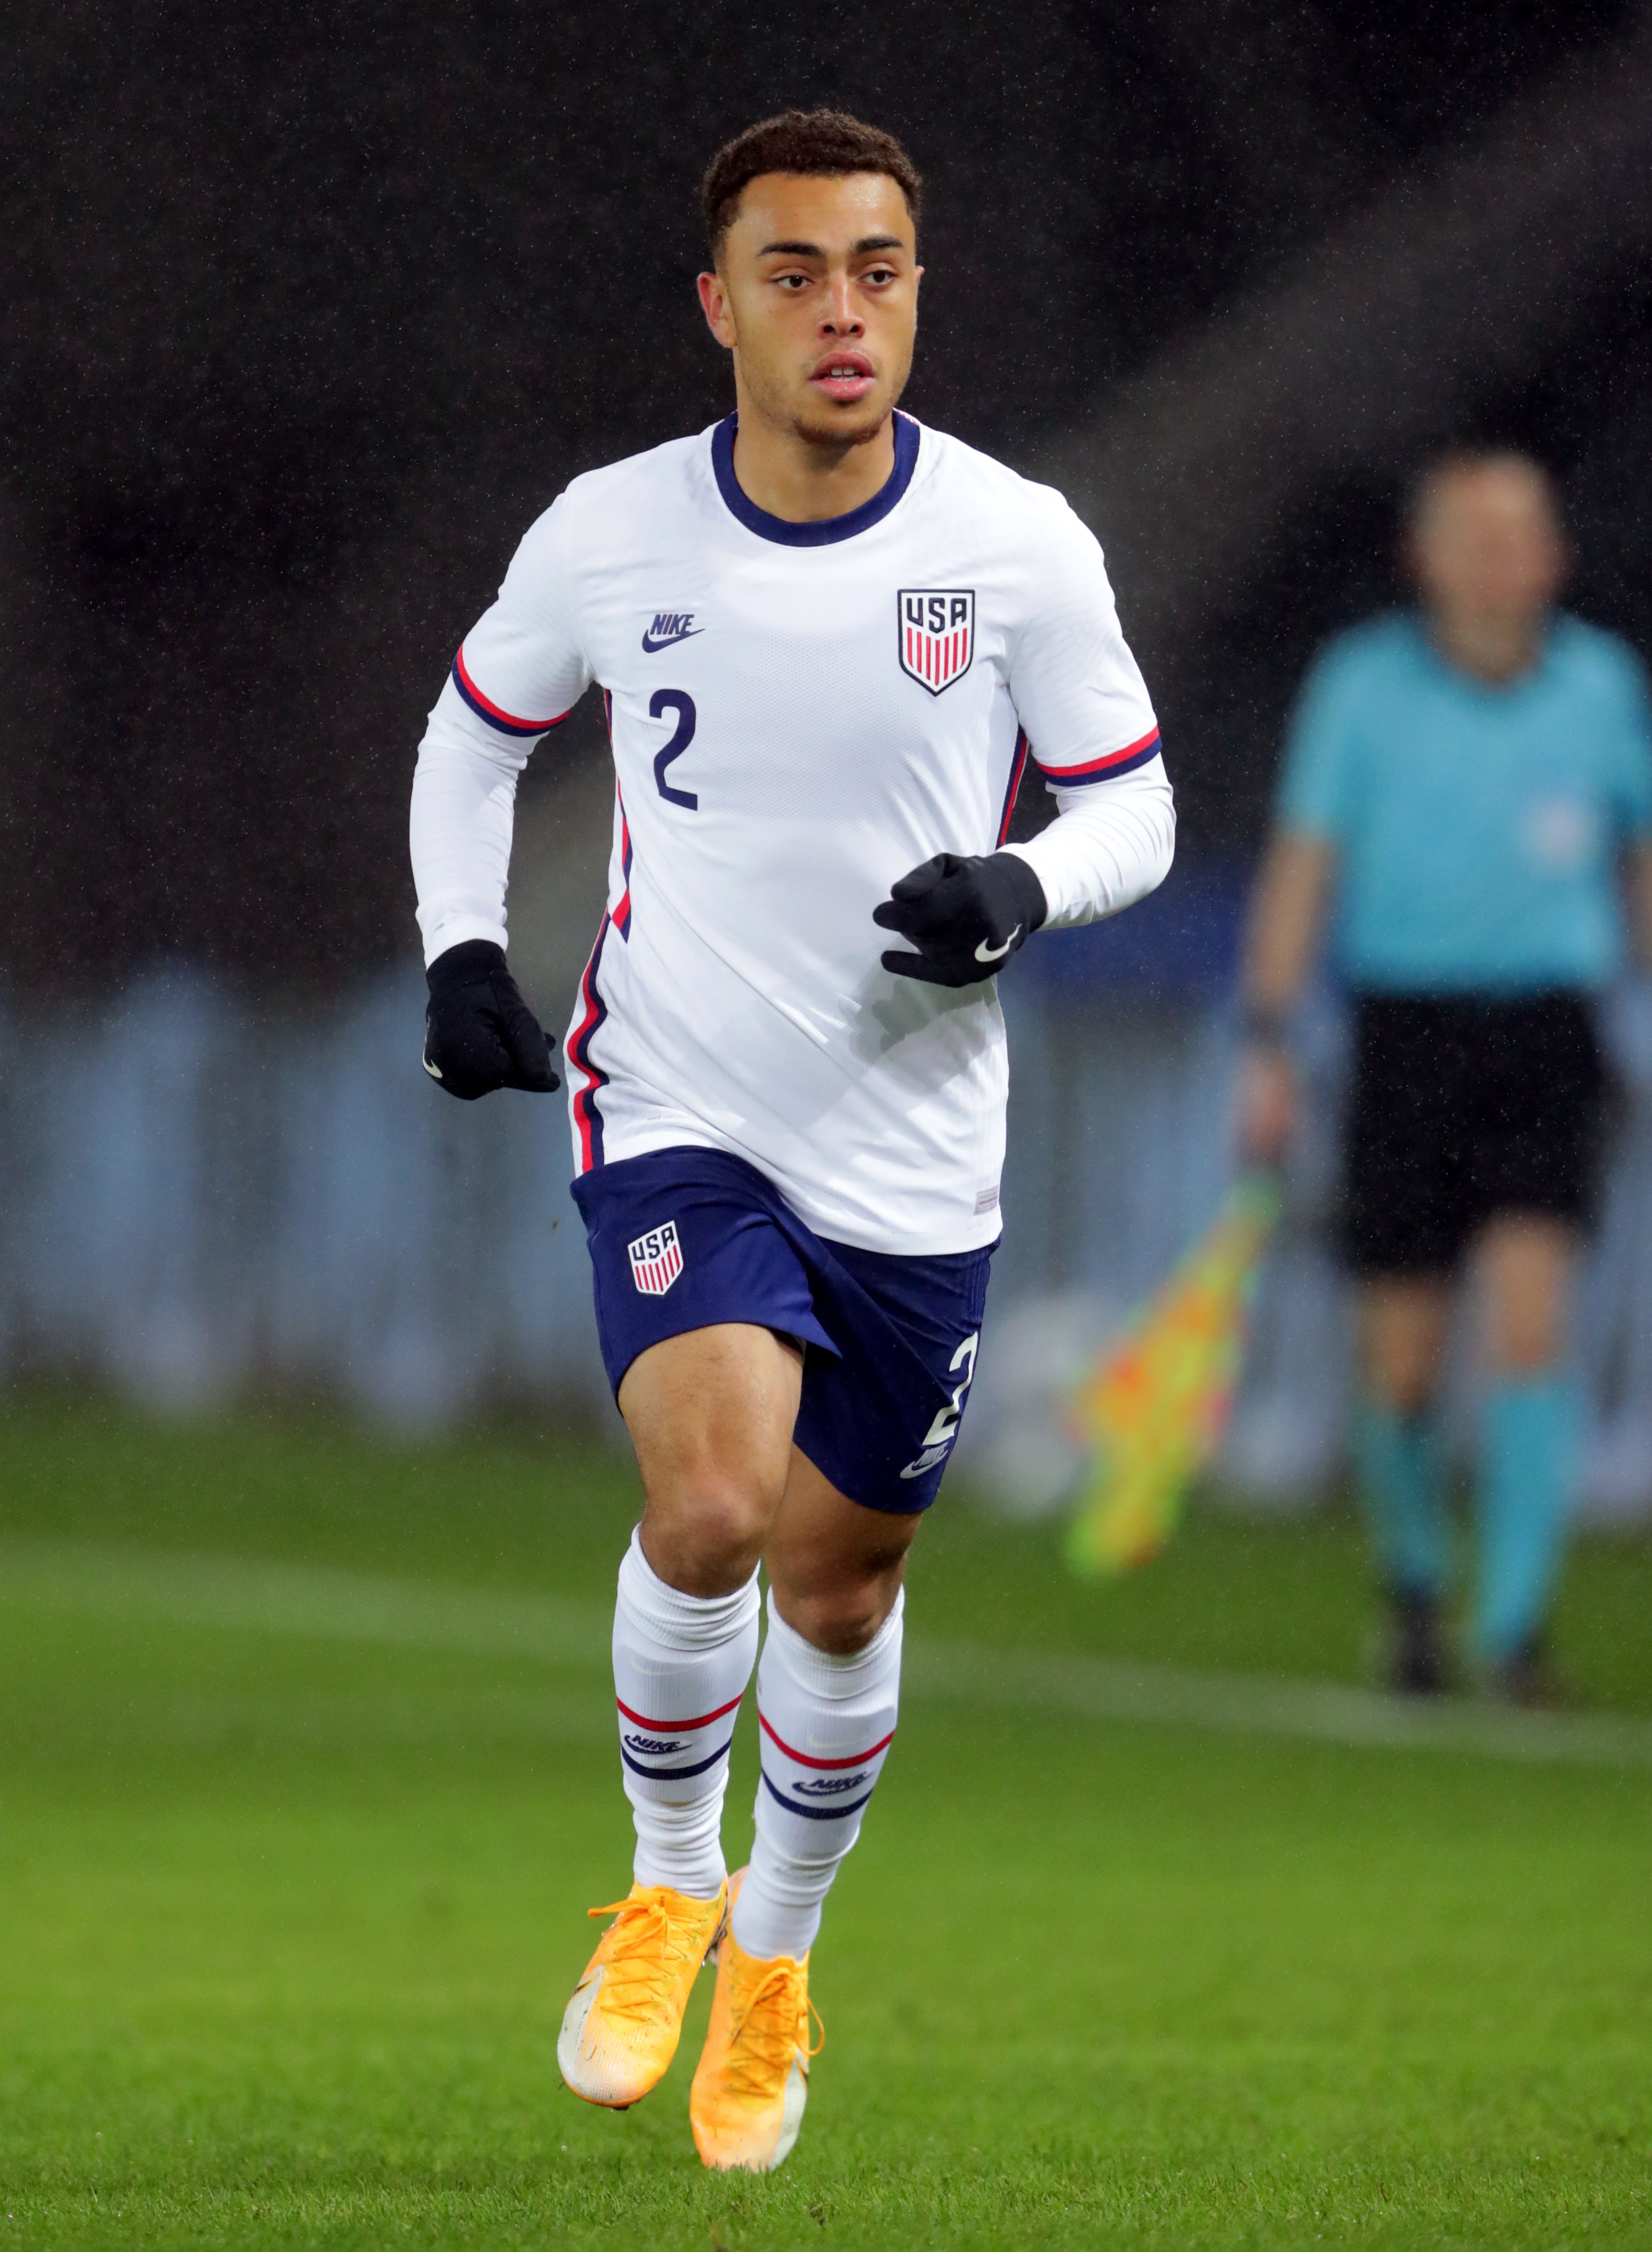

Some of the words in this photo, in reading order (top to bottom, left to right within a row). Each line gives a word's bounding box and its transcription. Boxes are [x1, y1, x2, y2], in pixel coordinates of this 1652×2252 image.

[650, 614, 695, 635] NIKE
[907, 597, 967, 634] USA
[649, 689, 698, 812] 2
[631, 1225, 674, 1261] USA
[922, 1331, 978, 1446] 2
[913, 1441, 948, 1467] NIKE
[631, 1735, 680, 1751] NIKE
